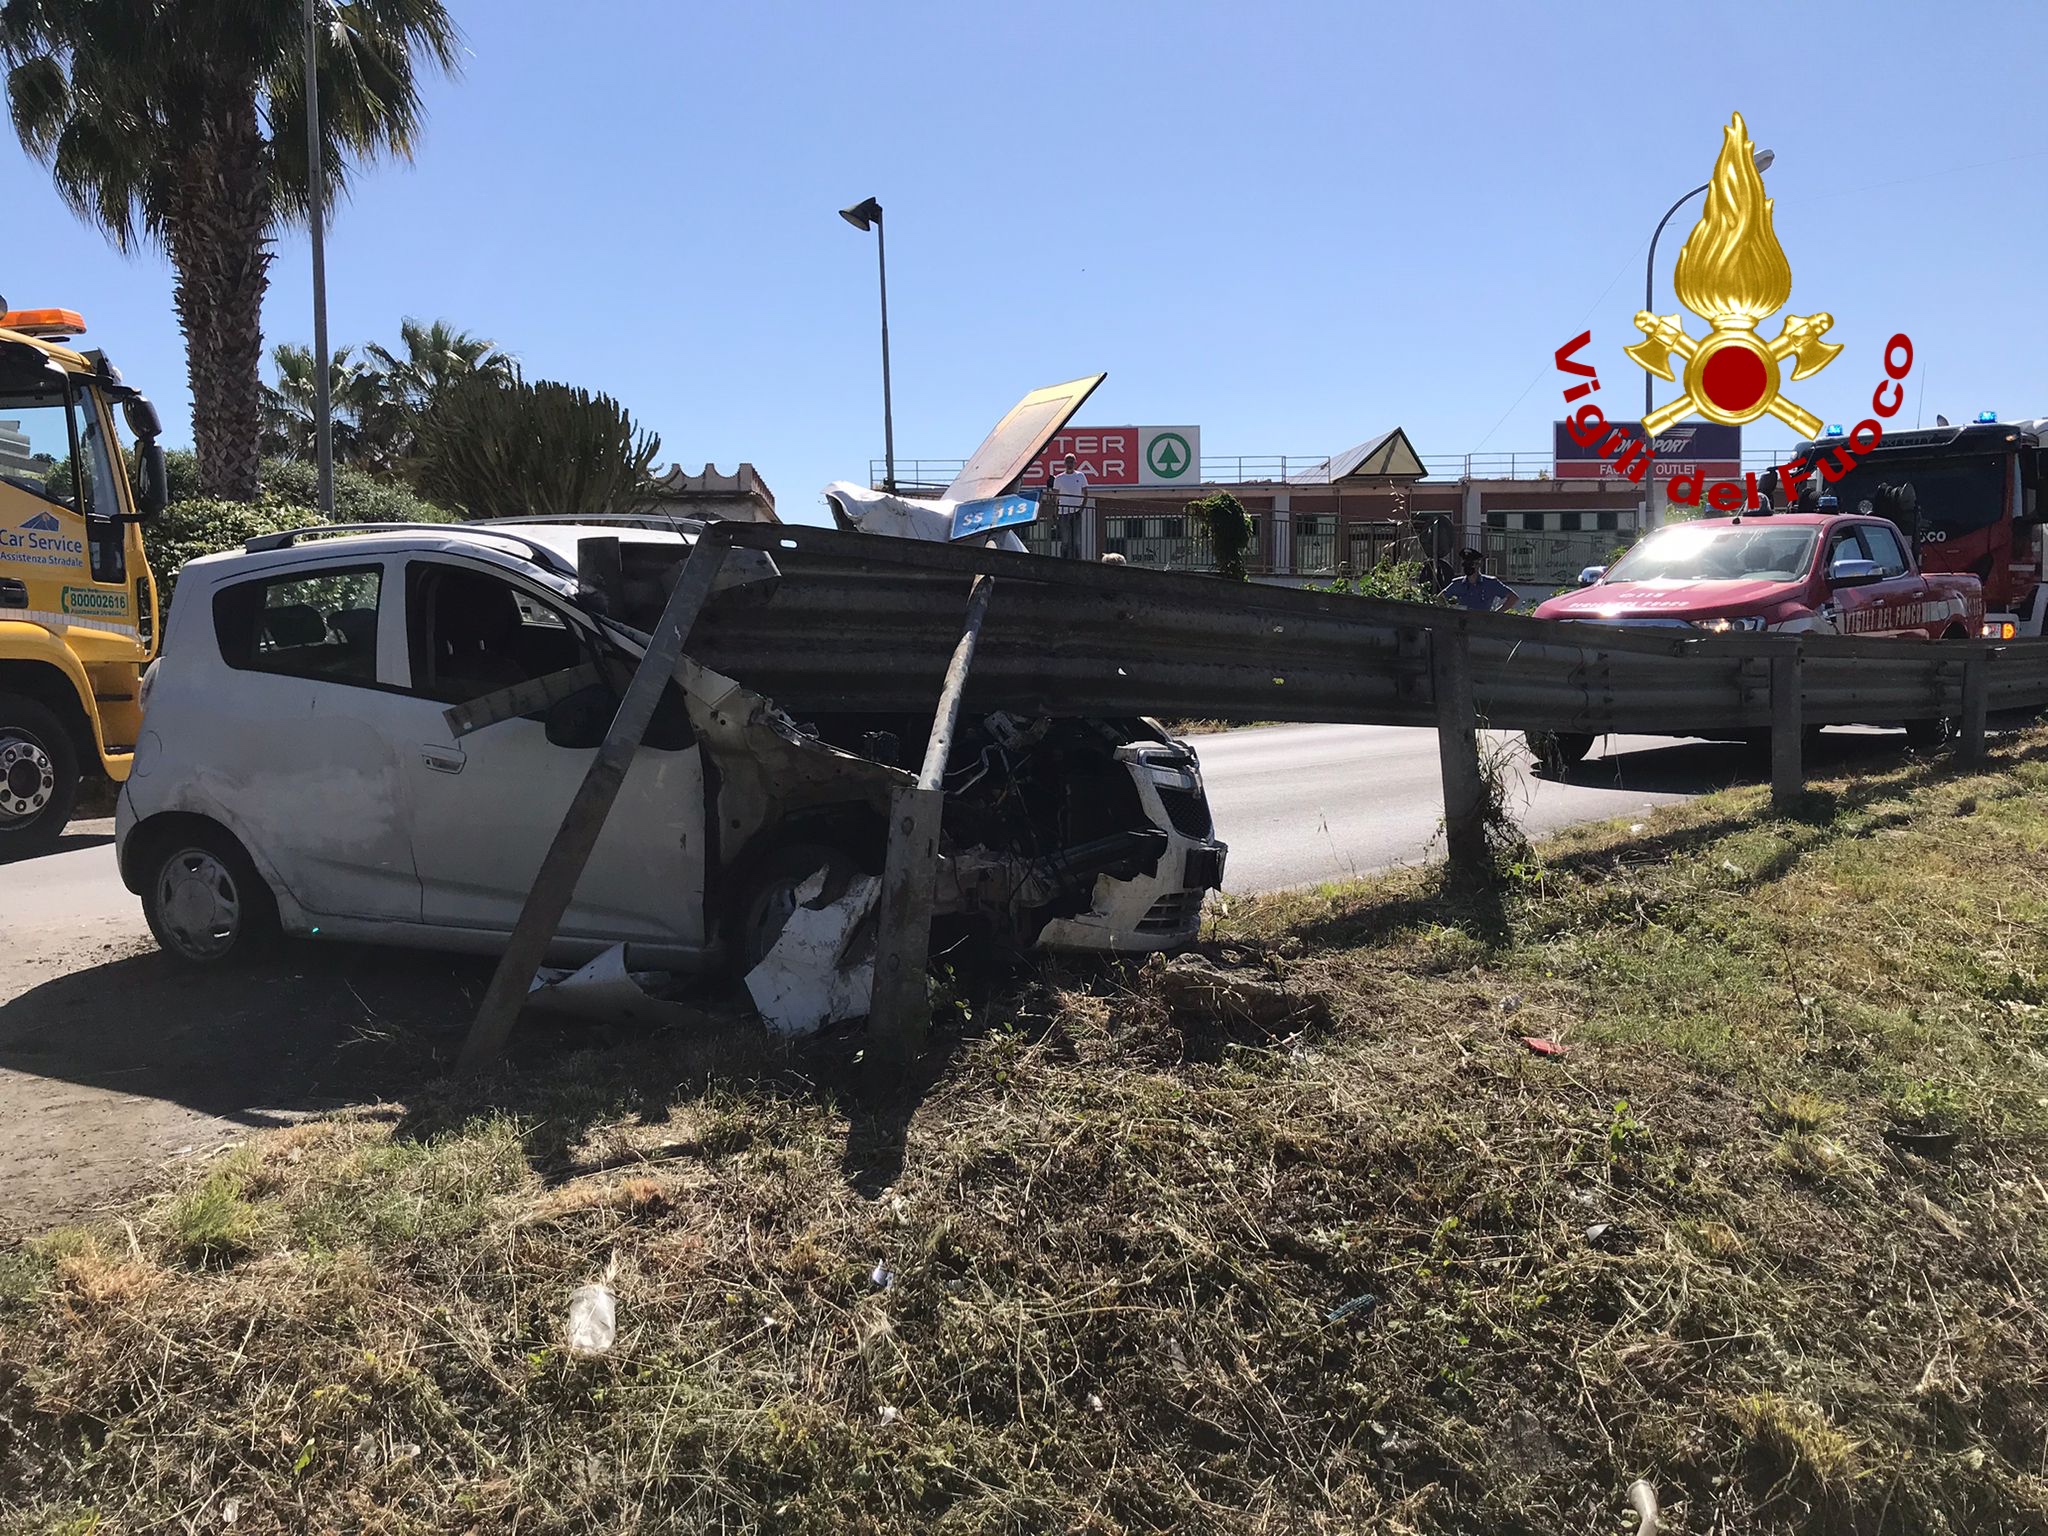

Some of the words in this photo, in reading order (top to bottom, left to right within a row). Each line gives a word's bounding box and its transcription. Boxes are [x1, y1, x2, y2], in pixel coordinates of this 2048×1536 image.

[1042, 436, 1125, 453] TER
[1656, 464, 1696, 475] OUTLET
[962, 511, 985, 527] SS
[997, 502, 1028, 519] 113
[0, 529, 24, 547] Car
[28, 532, 82, 553] Service
[0, 551, 47, 564] Assistenza
[48, 555, 84, 568] Stradale
[70, 592, 126, 609] 800002616
[1846, 609, 1875, 634] VIGILI
[1877, 606, 1893, 630] DEL
[1895, 602, 1922, 627] FUOCO
